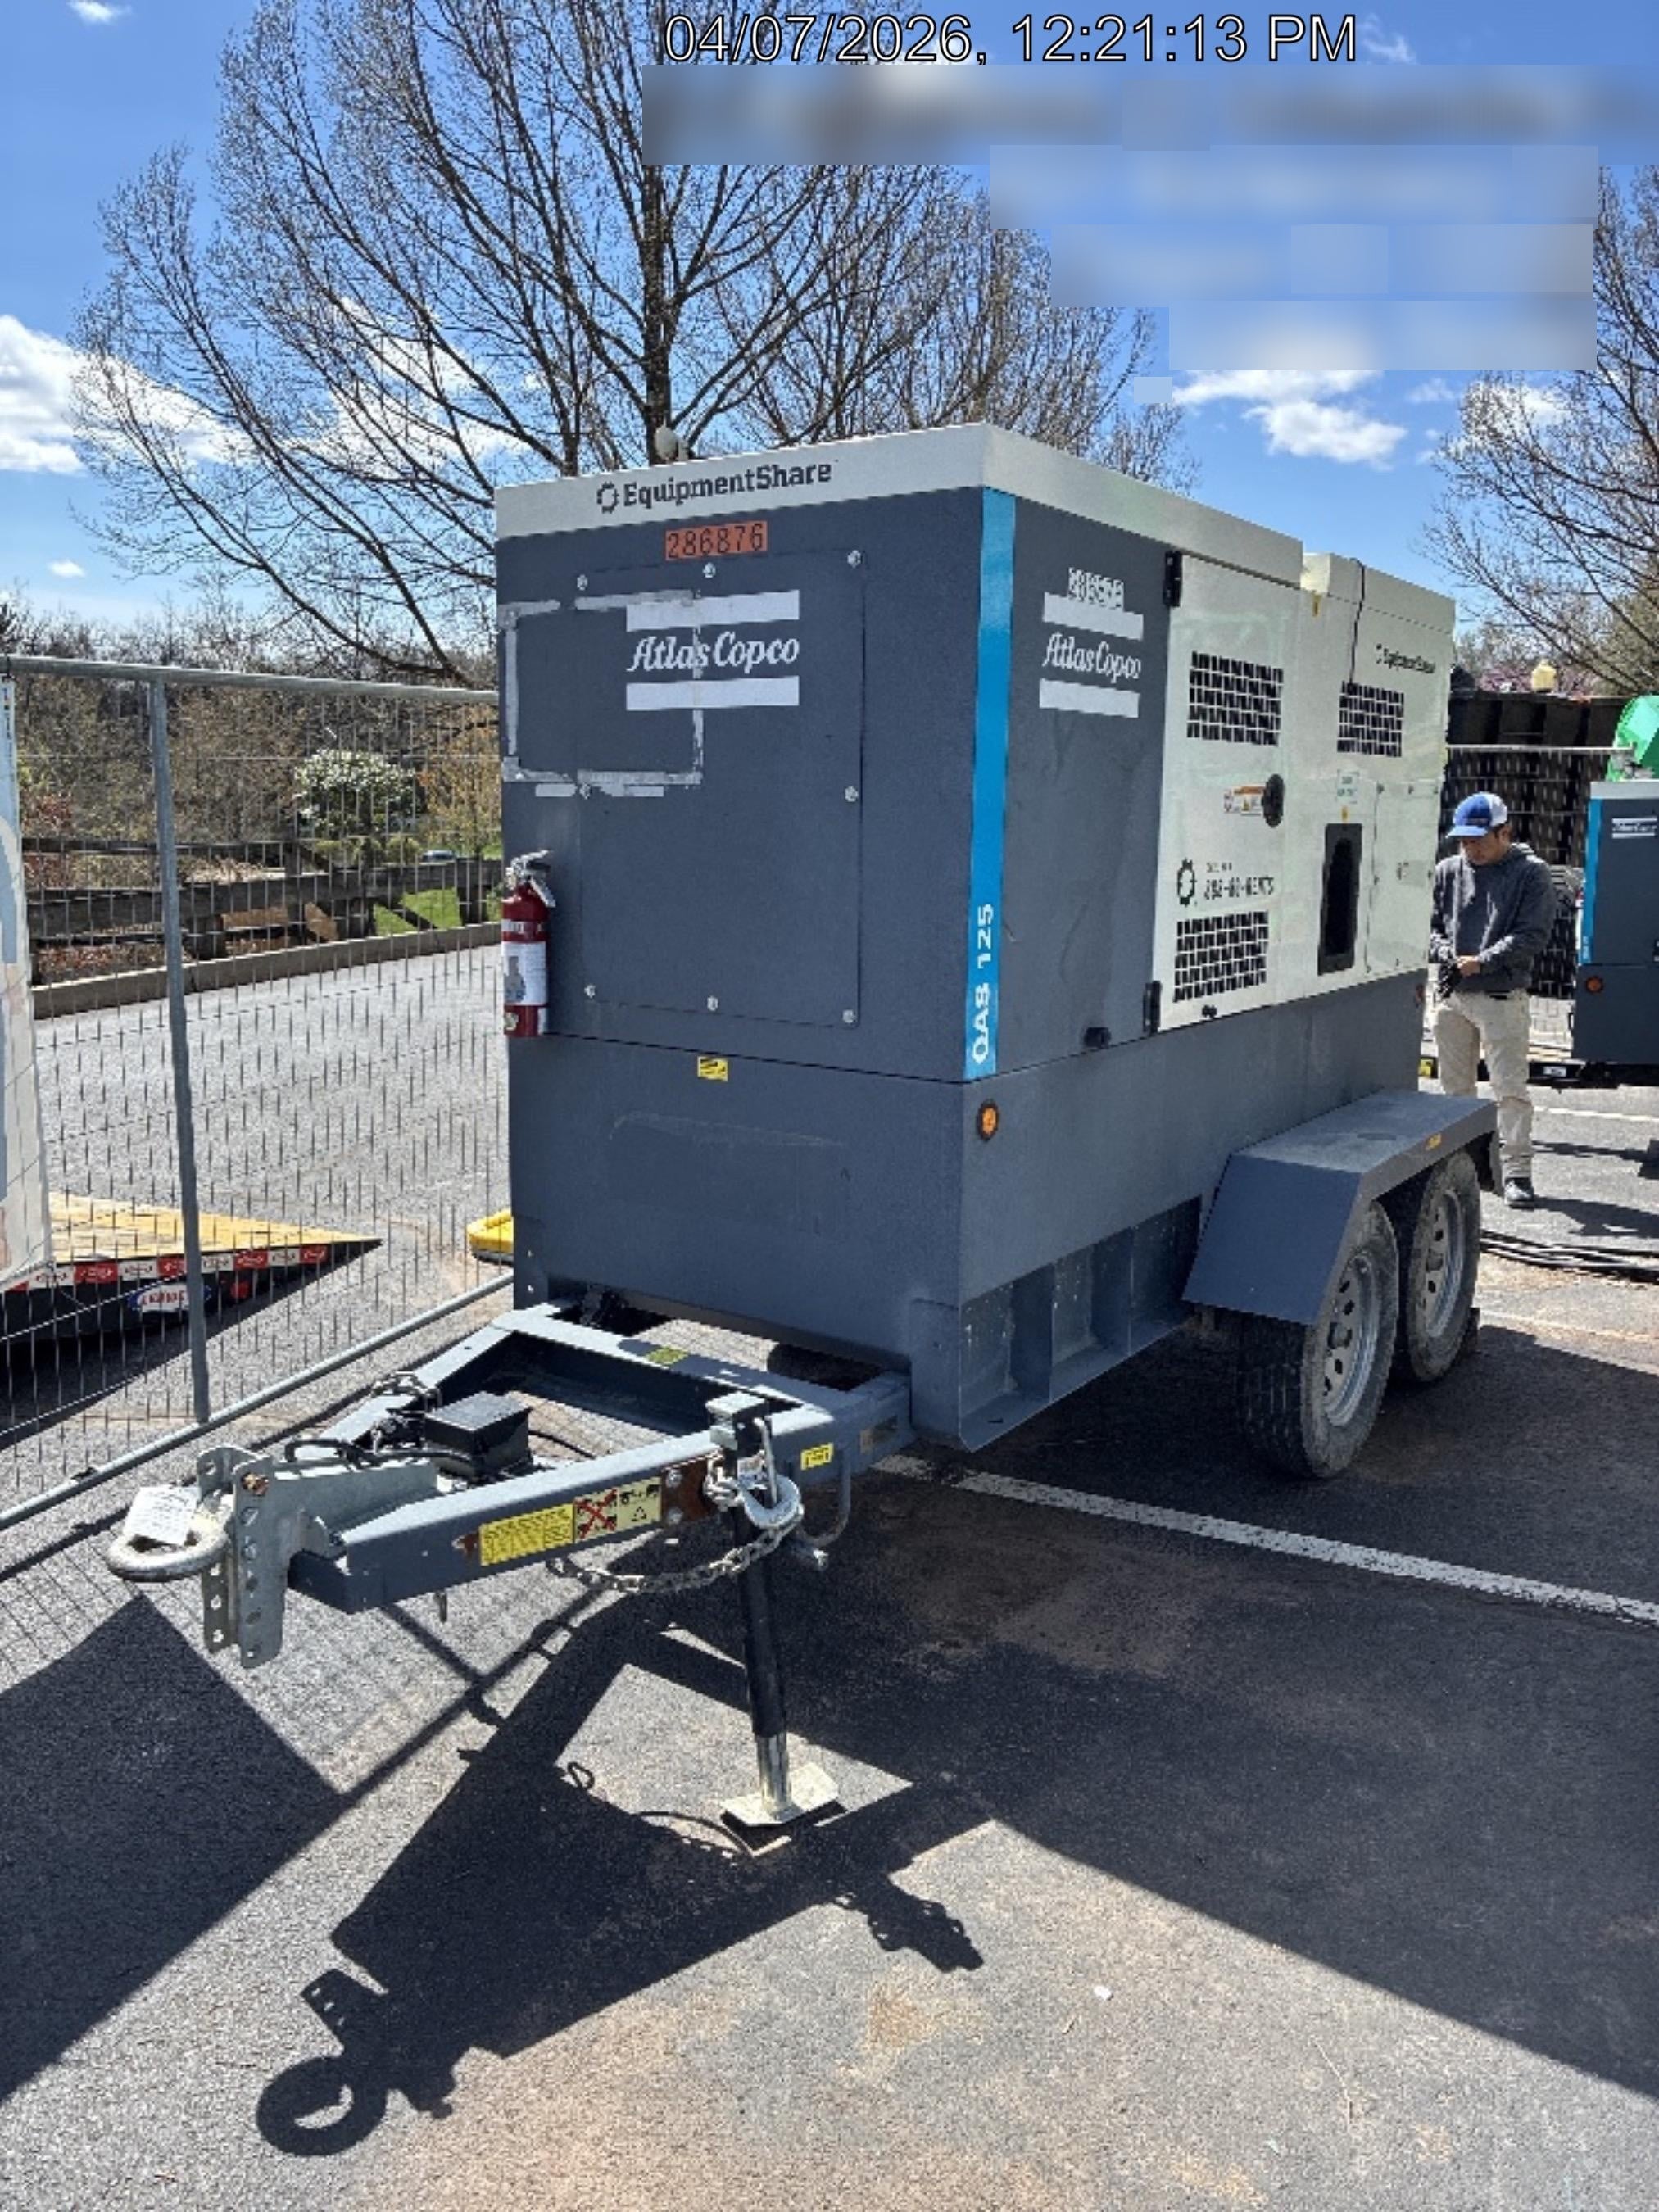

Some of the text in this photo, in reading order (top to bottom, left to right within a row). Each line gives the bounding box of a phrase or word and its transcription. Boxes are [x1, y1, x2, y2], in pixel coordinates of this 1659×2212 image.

[623, 463, 832, 510] EquipmentShare
[667, 522, 764, 556] 286876
[626, 630, 800, 674] Atlas Copco
[1042, 630, 1142, 684] Atlas Copco
[977, 903, 994, 970] 125
